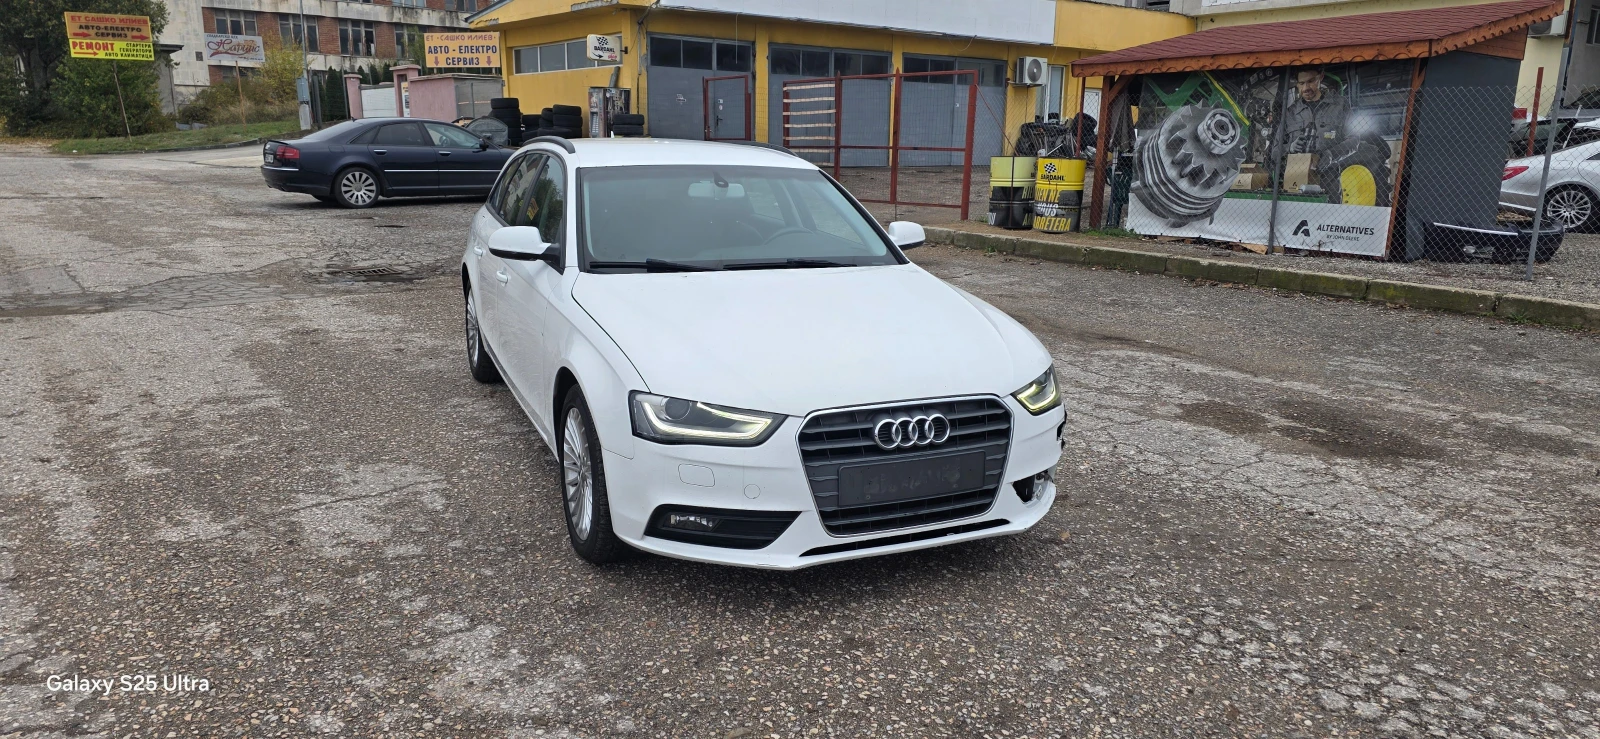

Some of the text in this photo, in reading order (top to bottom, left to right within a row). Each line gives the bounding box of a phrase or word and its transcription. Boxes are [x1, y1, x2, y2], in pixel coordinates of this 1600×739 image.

[72, 41, 114, 52] РЕМОНТ
[428, 46, 450, 54] АВТО
[458, 45, 497, 54] ЕЛЕКТРО
[446, 56, 480, 66] СЕРВИЗ
[1048, 188, 1060, 203] NE
[1316, 224, 1374, 236] ALTERNATIVES
